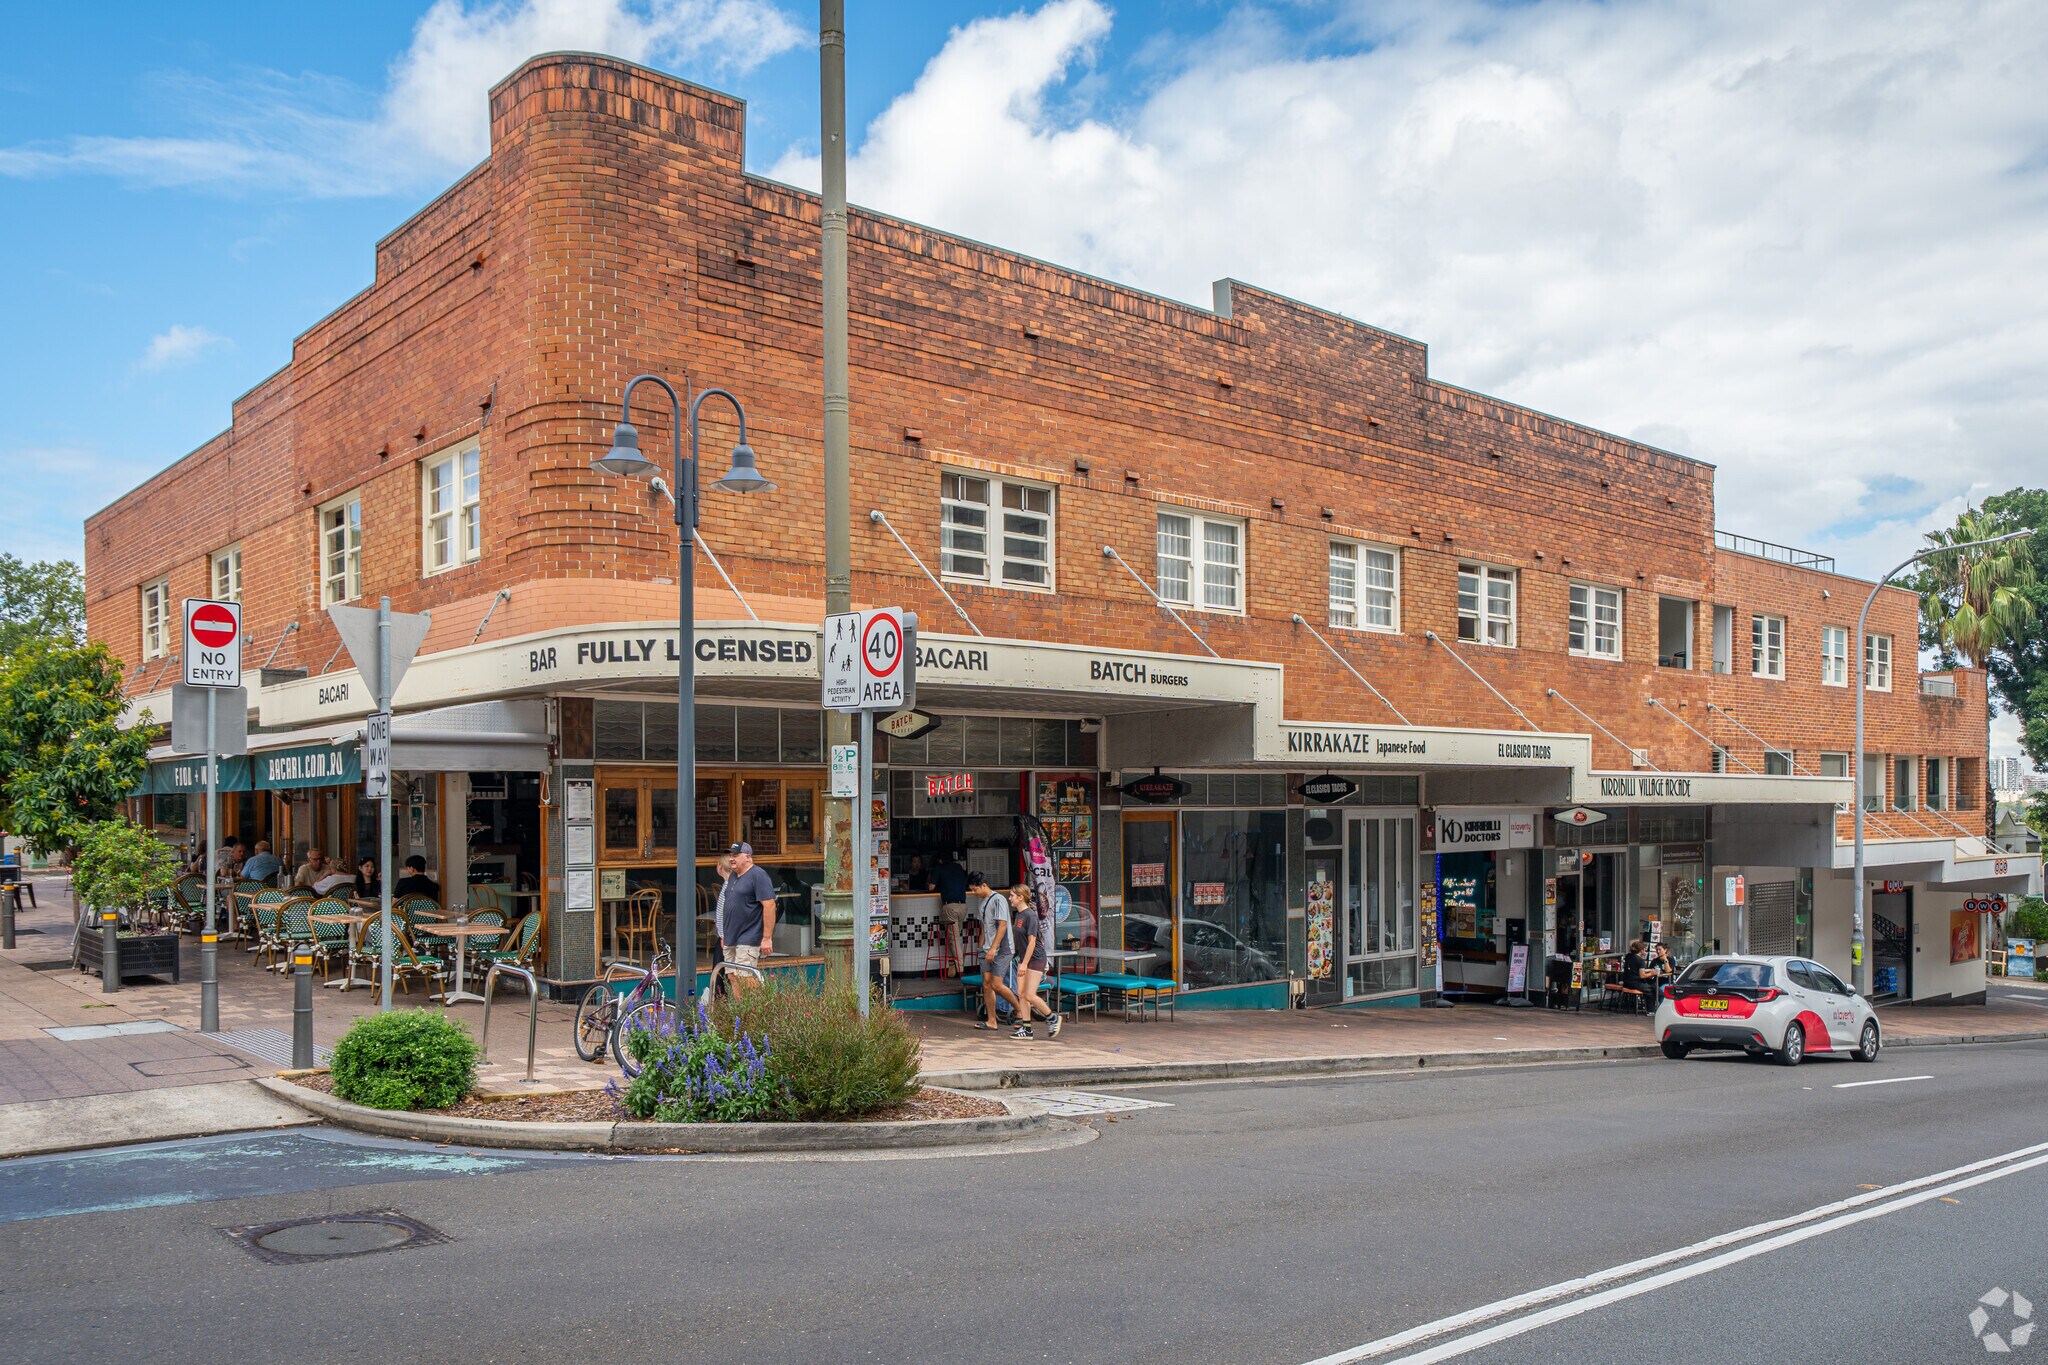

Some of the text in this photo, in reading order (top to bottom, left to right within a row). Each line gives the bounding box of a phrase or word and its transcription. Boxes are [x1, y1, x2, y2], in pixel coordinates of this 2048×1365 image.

[868, 631, 896, 659] 40
[201, 652, 226, 665] NO
[530, 639, 812, 672] BAR FULLY LCENSED
[915, 647, 988, 671] BACARI
[193, 668, 233, 680] ENTRY
[1090, 660, 1188, 686] BATCH BURGERS
[319, 683, 348, 705] BACARI
[863, 681, 901, 701] AREA
[371, 721, 386, 740] ONE
[891, 714, 913, 730] BATCH
[1288, 732, 1426, 757] KIRRAKAZE Japanese Food
[1498, 743, 1505, 758] EL
[1532, 745, 1551, 759] TACOS
[370, 747, 387, 766] WAY
[201, 764, 220, 785] WE
[927, 773, 973, 797] BATCH
[1331, 782, 1347, 793] TACOS
[1601, 777, 1691, 797] KIRRIBILLI VILLAGE ARCADE
[1464, 820, 1501, 832] KIRRIBILLI
[1464, 832, 1501, 842] DOCTORS
[1968, 902, 1999, 910] BWS
